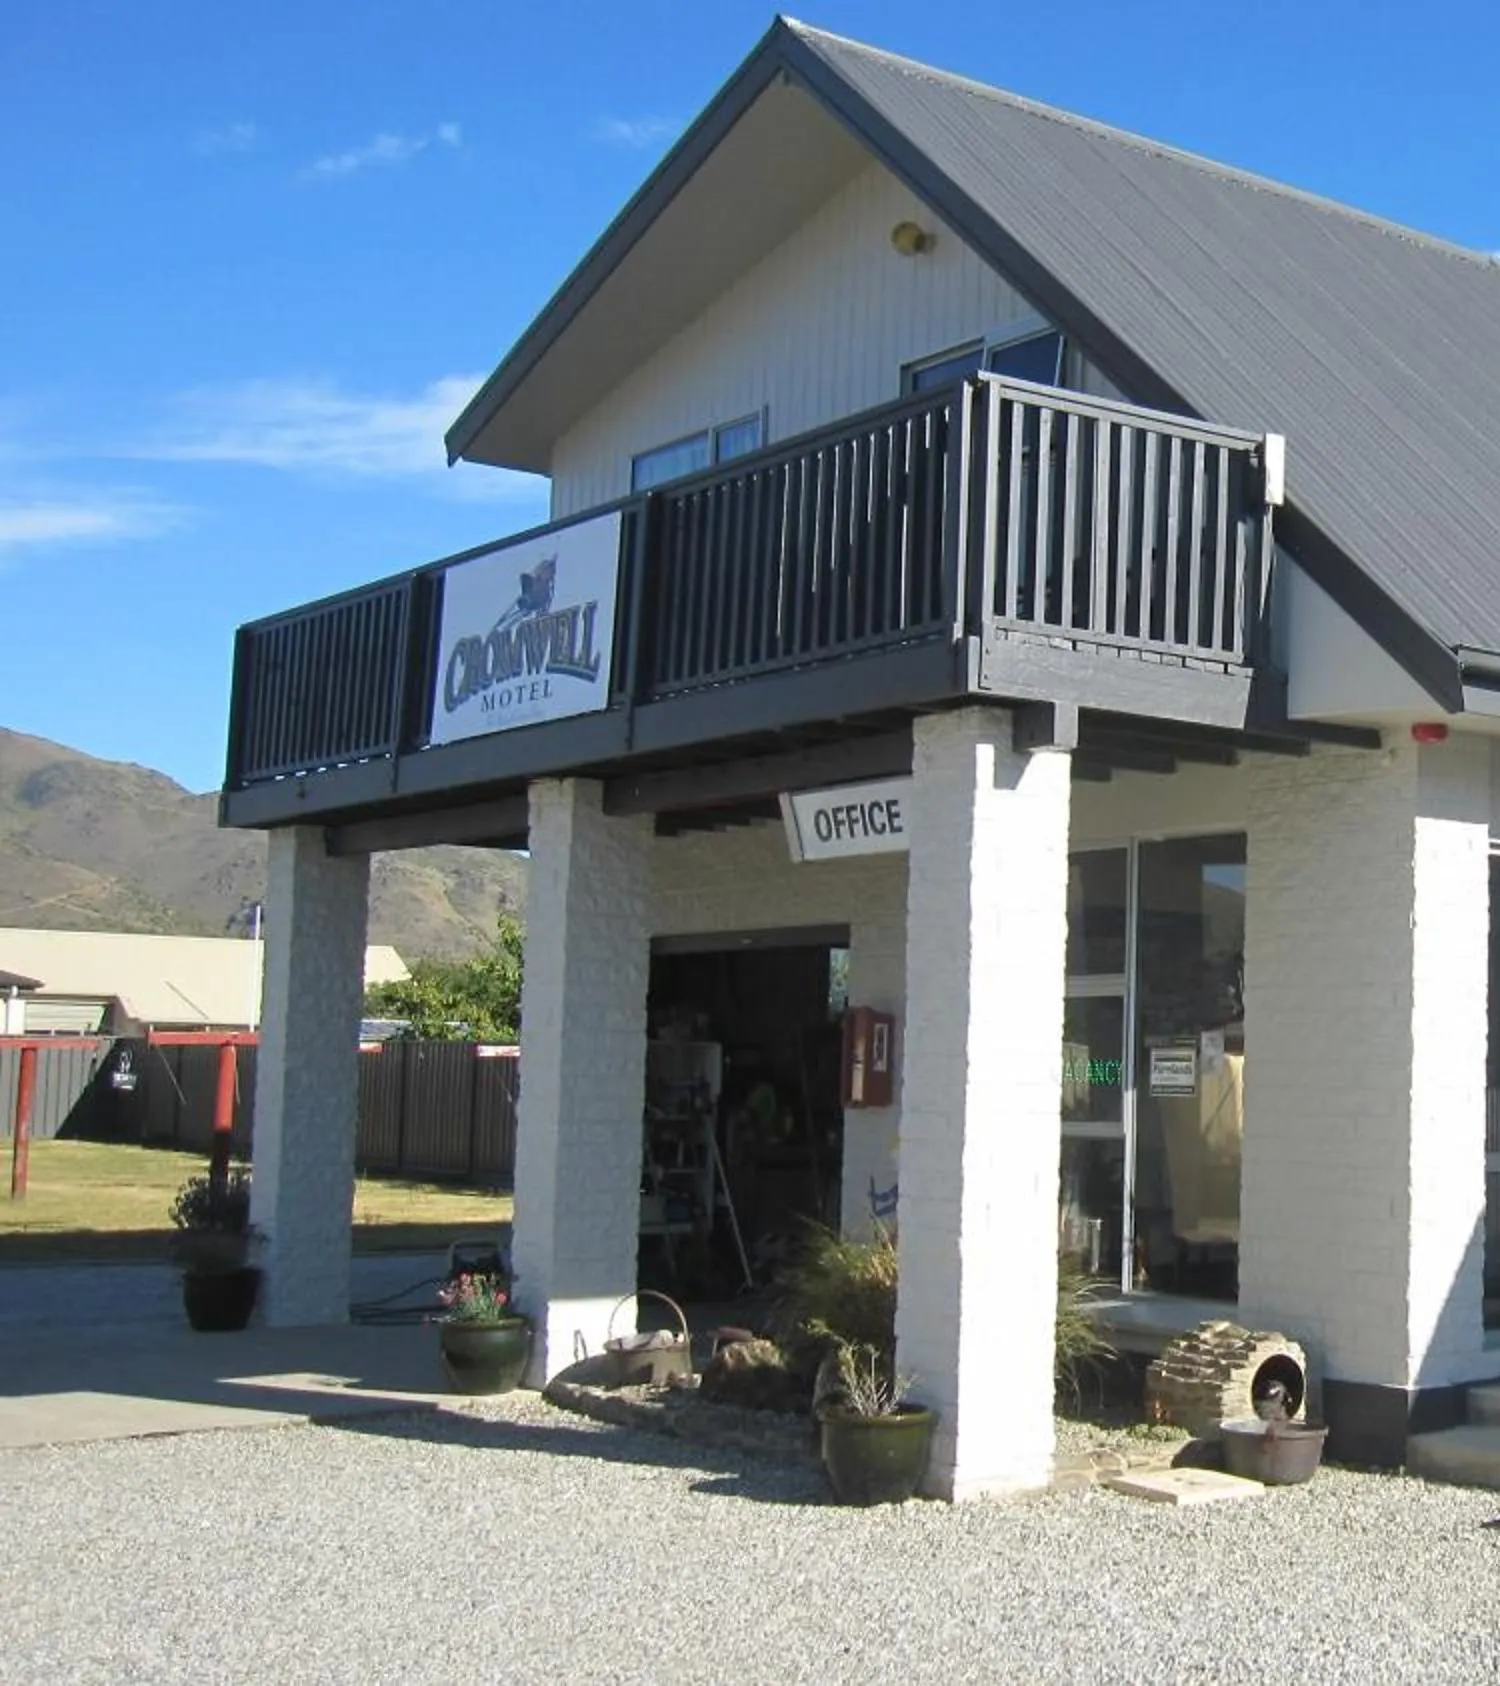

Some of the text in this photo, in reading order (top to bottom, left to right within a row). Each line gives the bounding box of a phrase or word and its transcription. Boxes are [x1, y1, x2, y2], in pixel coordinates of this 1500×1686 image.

[444, 600, 601, 713] CROMWELL
[481, 680, 553, 713] MOTEL
[814, 799, 903, 842] OFFICE
